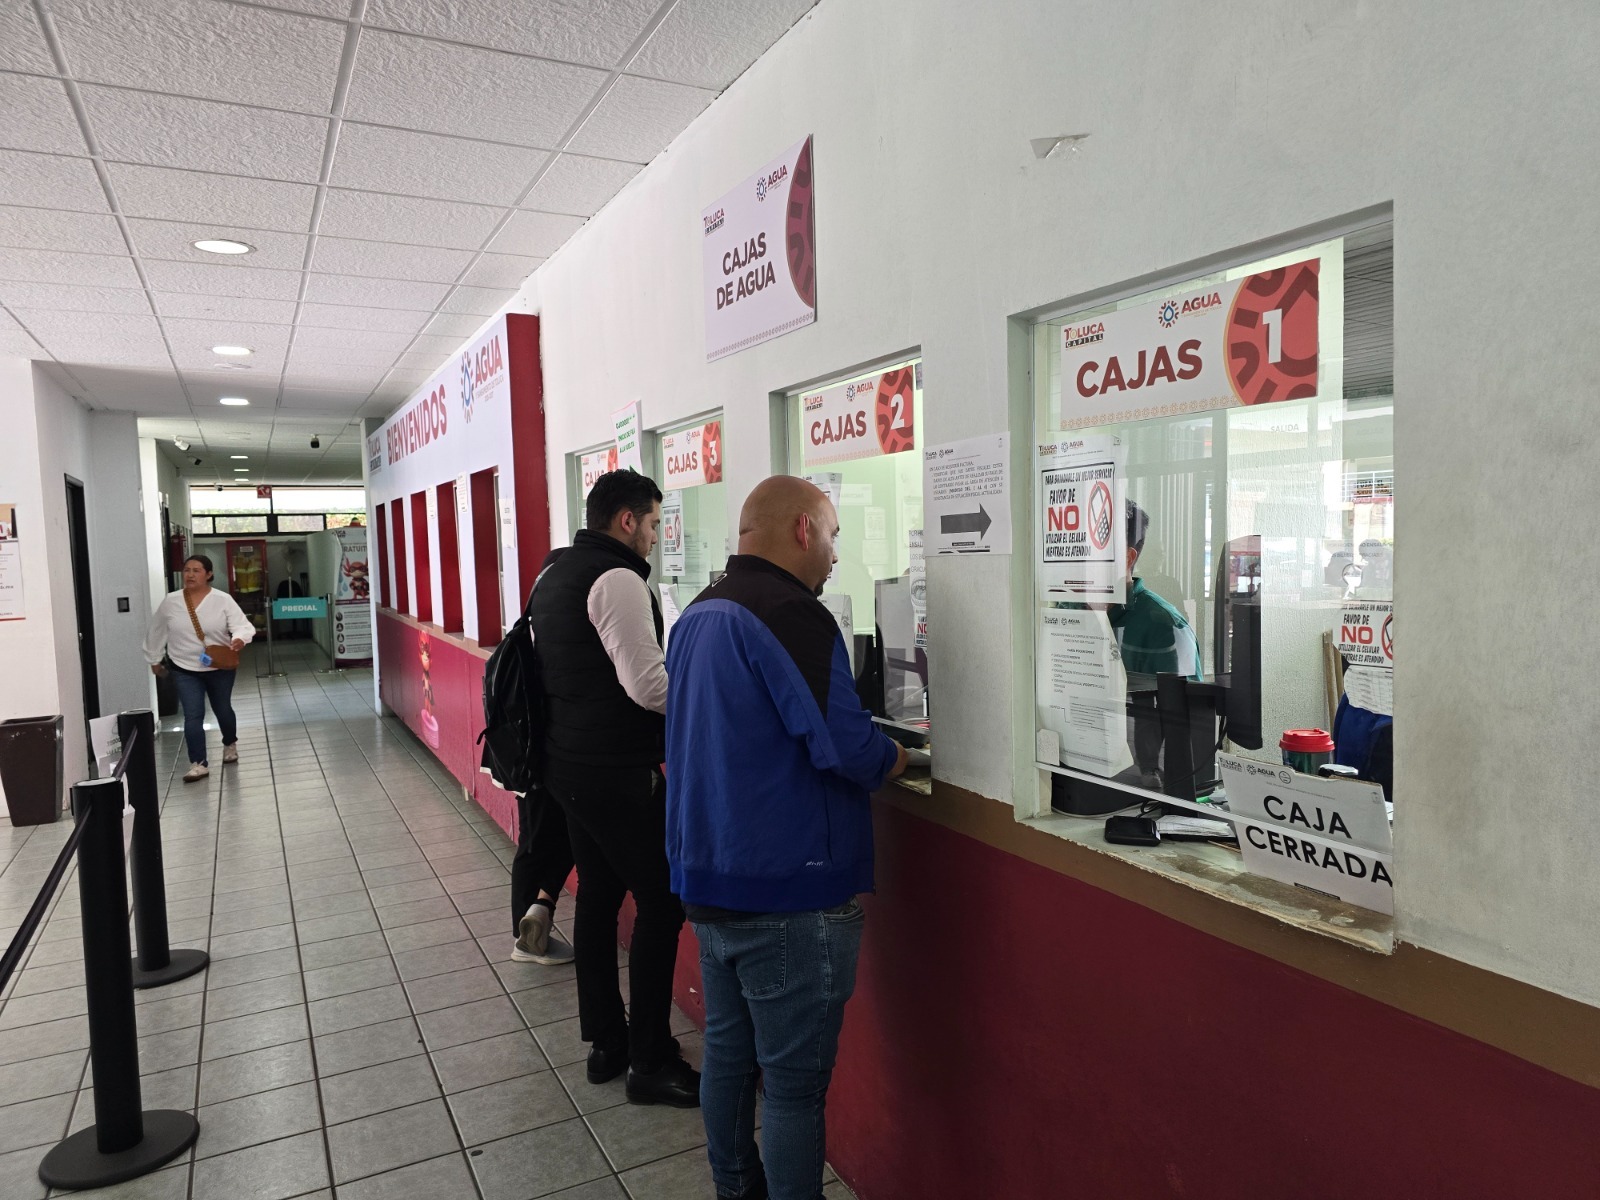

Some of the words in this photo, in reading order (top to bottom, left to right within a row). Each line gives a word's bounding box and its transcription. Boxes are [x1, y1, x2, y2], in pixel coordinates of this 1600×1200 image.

[767, 165, 788, 187] AGUA
[704, 207, 725, 227] TOLUCA
[722, 232, 767, 276] CAJAS
[716, 285, 734, 311] DE
[735, 261, 777, 302] AGUA
[1181, 292, 1222, 314] AGUA
[1064, 322, 1105, 341] TOLUCA
[475, 334, 504, 389] AGUA
[1076, 338, 1203, 398] CAJAS
[1262, 308, 1283, 365] 1
[856, 381, 874, 394] AGUA
[386, 383, 448, 466] BIENVENIDOS
[810, 410, 867, 446] CAJAS
[890, 393, 905, 430] 2
[667, 450, 698, 475] CAJAS
[709, 440, 718, 467] 3
[1050, 488, 1067, 505] FAVOR
[1067, 488, 1076, 503] DE
[1047, 504, 1080, 532] NO
[664, 525, 673, 540] NO
[1062, 532, 1068, 544] EL
[1068, 531, 1087, 543] CELULAR
[1046, 546, 1065, 558] MIENTRAS
[1065, 546, 1071, 557] ES
[281, 605, 318, 613] PREDIAL
[1343, 613, 1361, 625] FAVOR
[1362, 614, 1370, 626] DE
[1341, 625, 1374, 645] NO
[1338, 643, 1356, 652] UTILIZAR
[1356, 644, 1362, 653] EL
[1362, 645, 1380, 655] CELULAR
[1364, 654, 1385, 664] ATENDIDO
[1257, 767, 1276, 777] AGUA
[1263, 795, 1353, 840] CAJA
[1245, 825, 1393, 887] CERRADA
